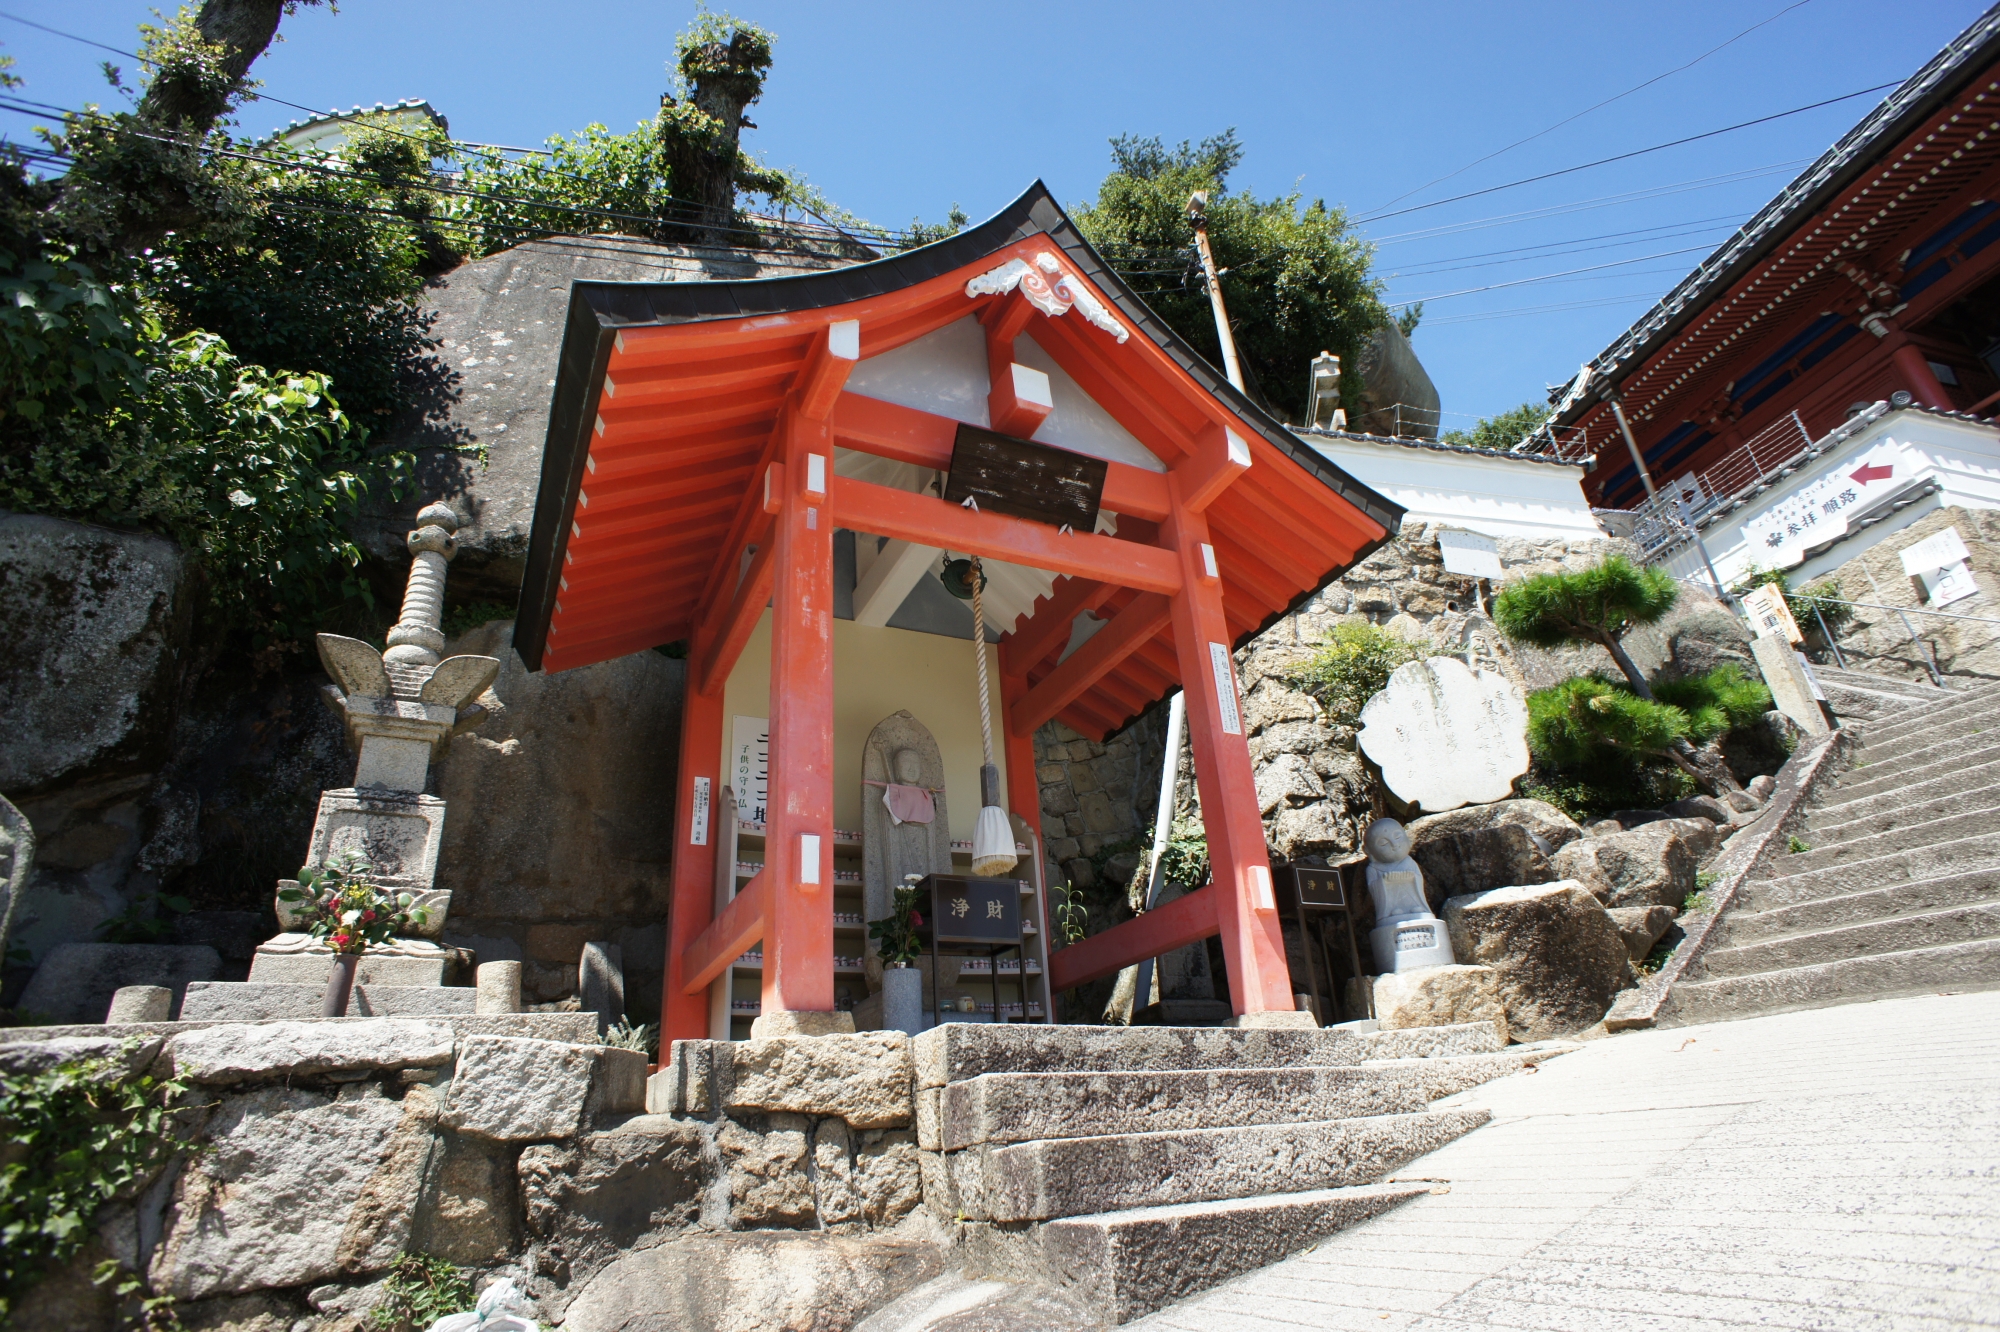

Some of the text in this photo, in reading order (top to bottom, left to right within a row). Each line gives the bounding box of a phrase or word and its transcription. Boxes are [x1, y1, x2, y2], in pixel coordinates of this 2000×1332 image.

[1787, 488, 1857, 538] 参拝 順路
[1937, 566, 1955, 588] 入口
[738, 744, 750, 809] 子供の守り仏
[951, 897, 1005, 919] 浄財
